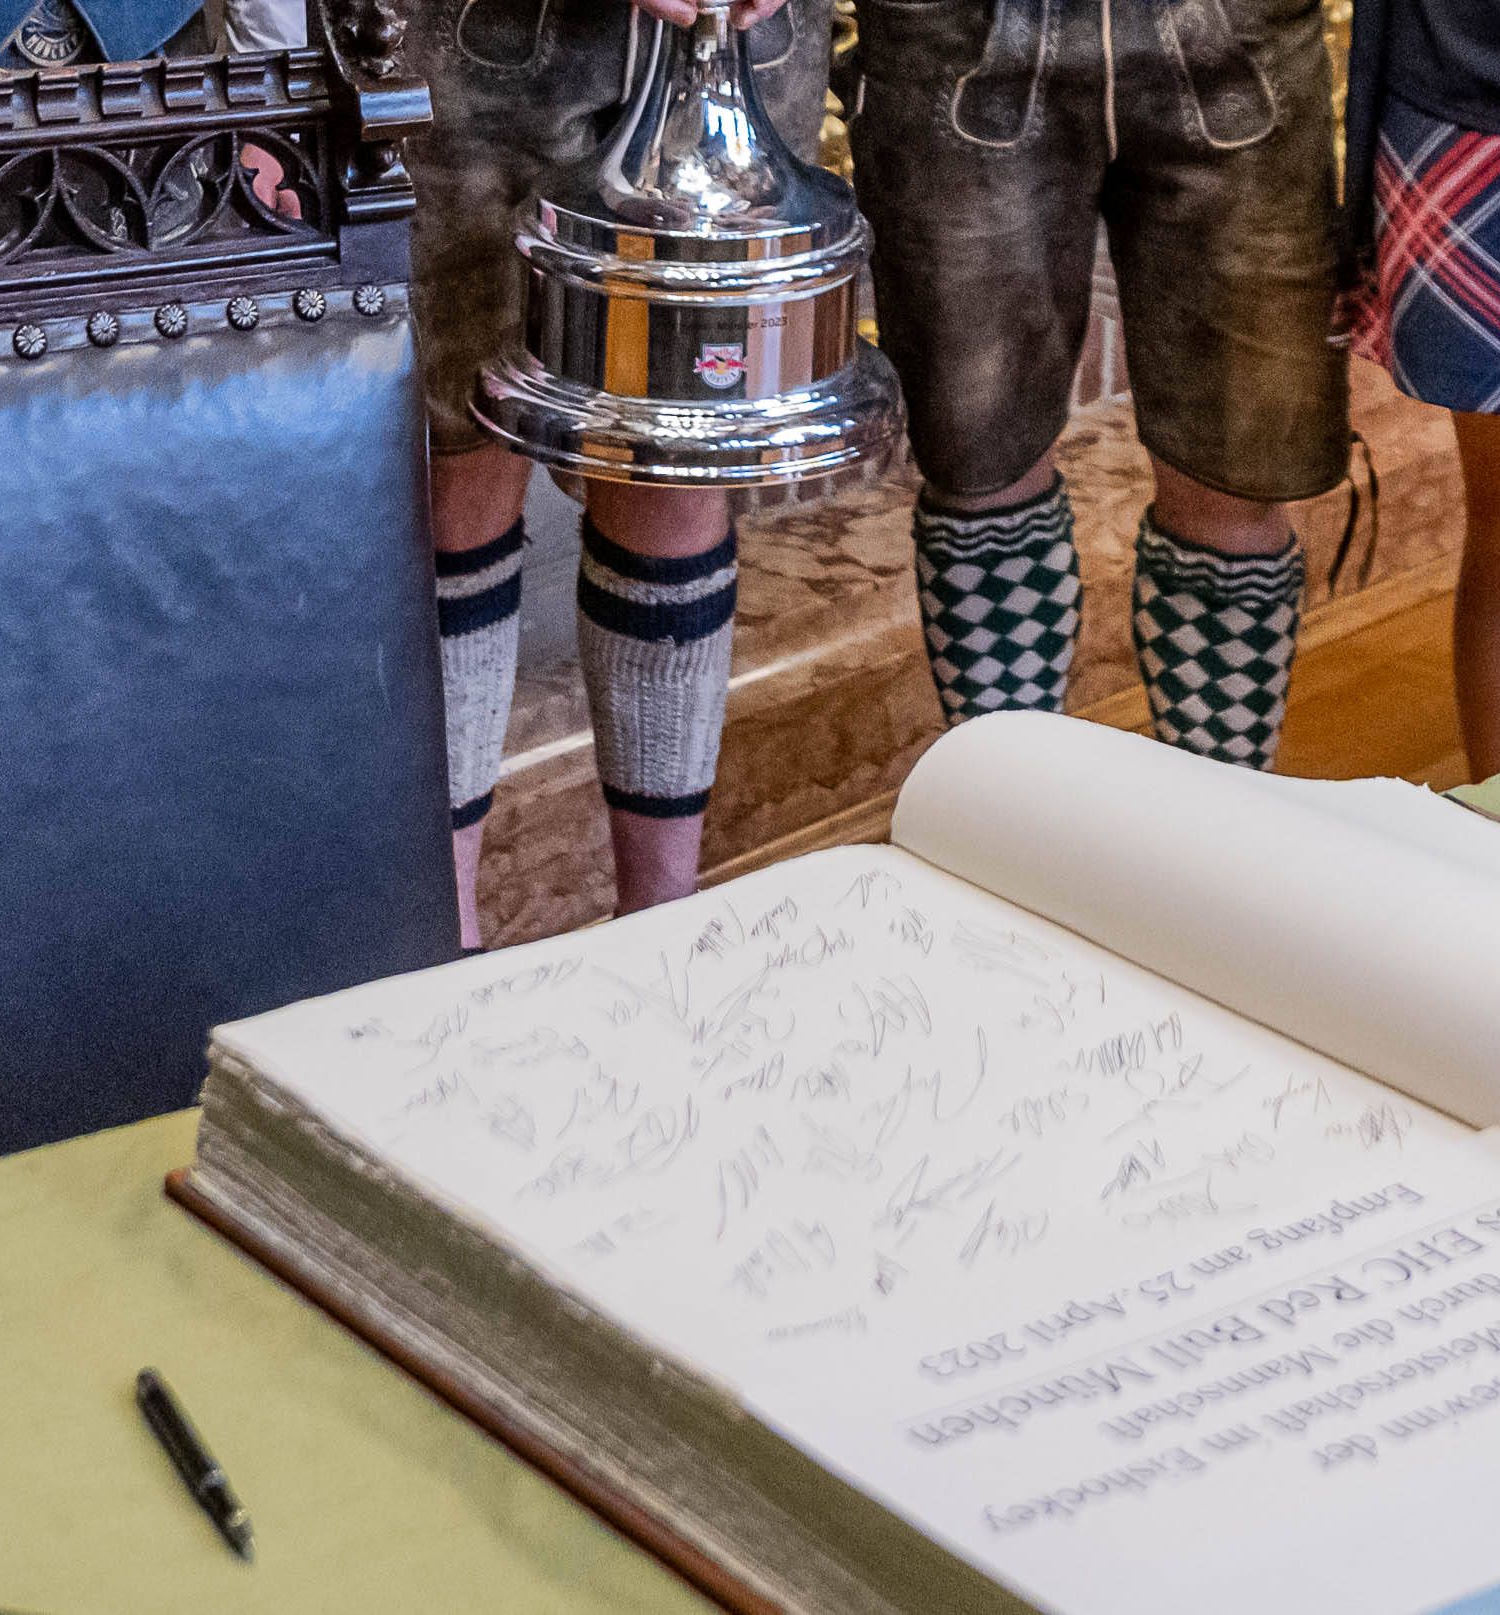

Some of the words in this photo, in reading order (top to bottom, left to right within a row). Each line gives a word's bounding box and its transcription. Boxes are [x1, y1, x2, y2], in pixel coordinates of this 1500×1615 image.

[760, 316, 788, 328] 2023
[1246, 1182, 1425, 1250] Empfang
[1188, 1244, 1251, 1276] am
[1361, 1226, 1485, 1284] EHC
[1258, 1275, 1368, 1327] Red
[919, 1331, 1027, 1377] 2023
[1149, 1313, 1266, 1369] Bull
[1332, 1317, 1396, 1348] die
[907, 1354, 1157, 1446] München
[1099, 1343, 1339, 1441] Mannschaft
[1201, 1422, 1273, 1453] im
[1312, 1433, 1380, 1471] der
[981, 1446, 1207, 1533] Eishockey
